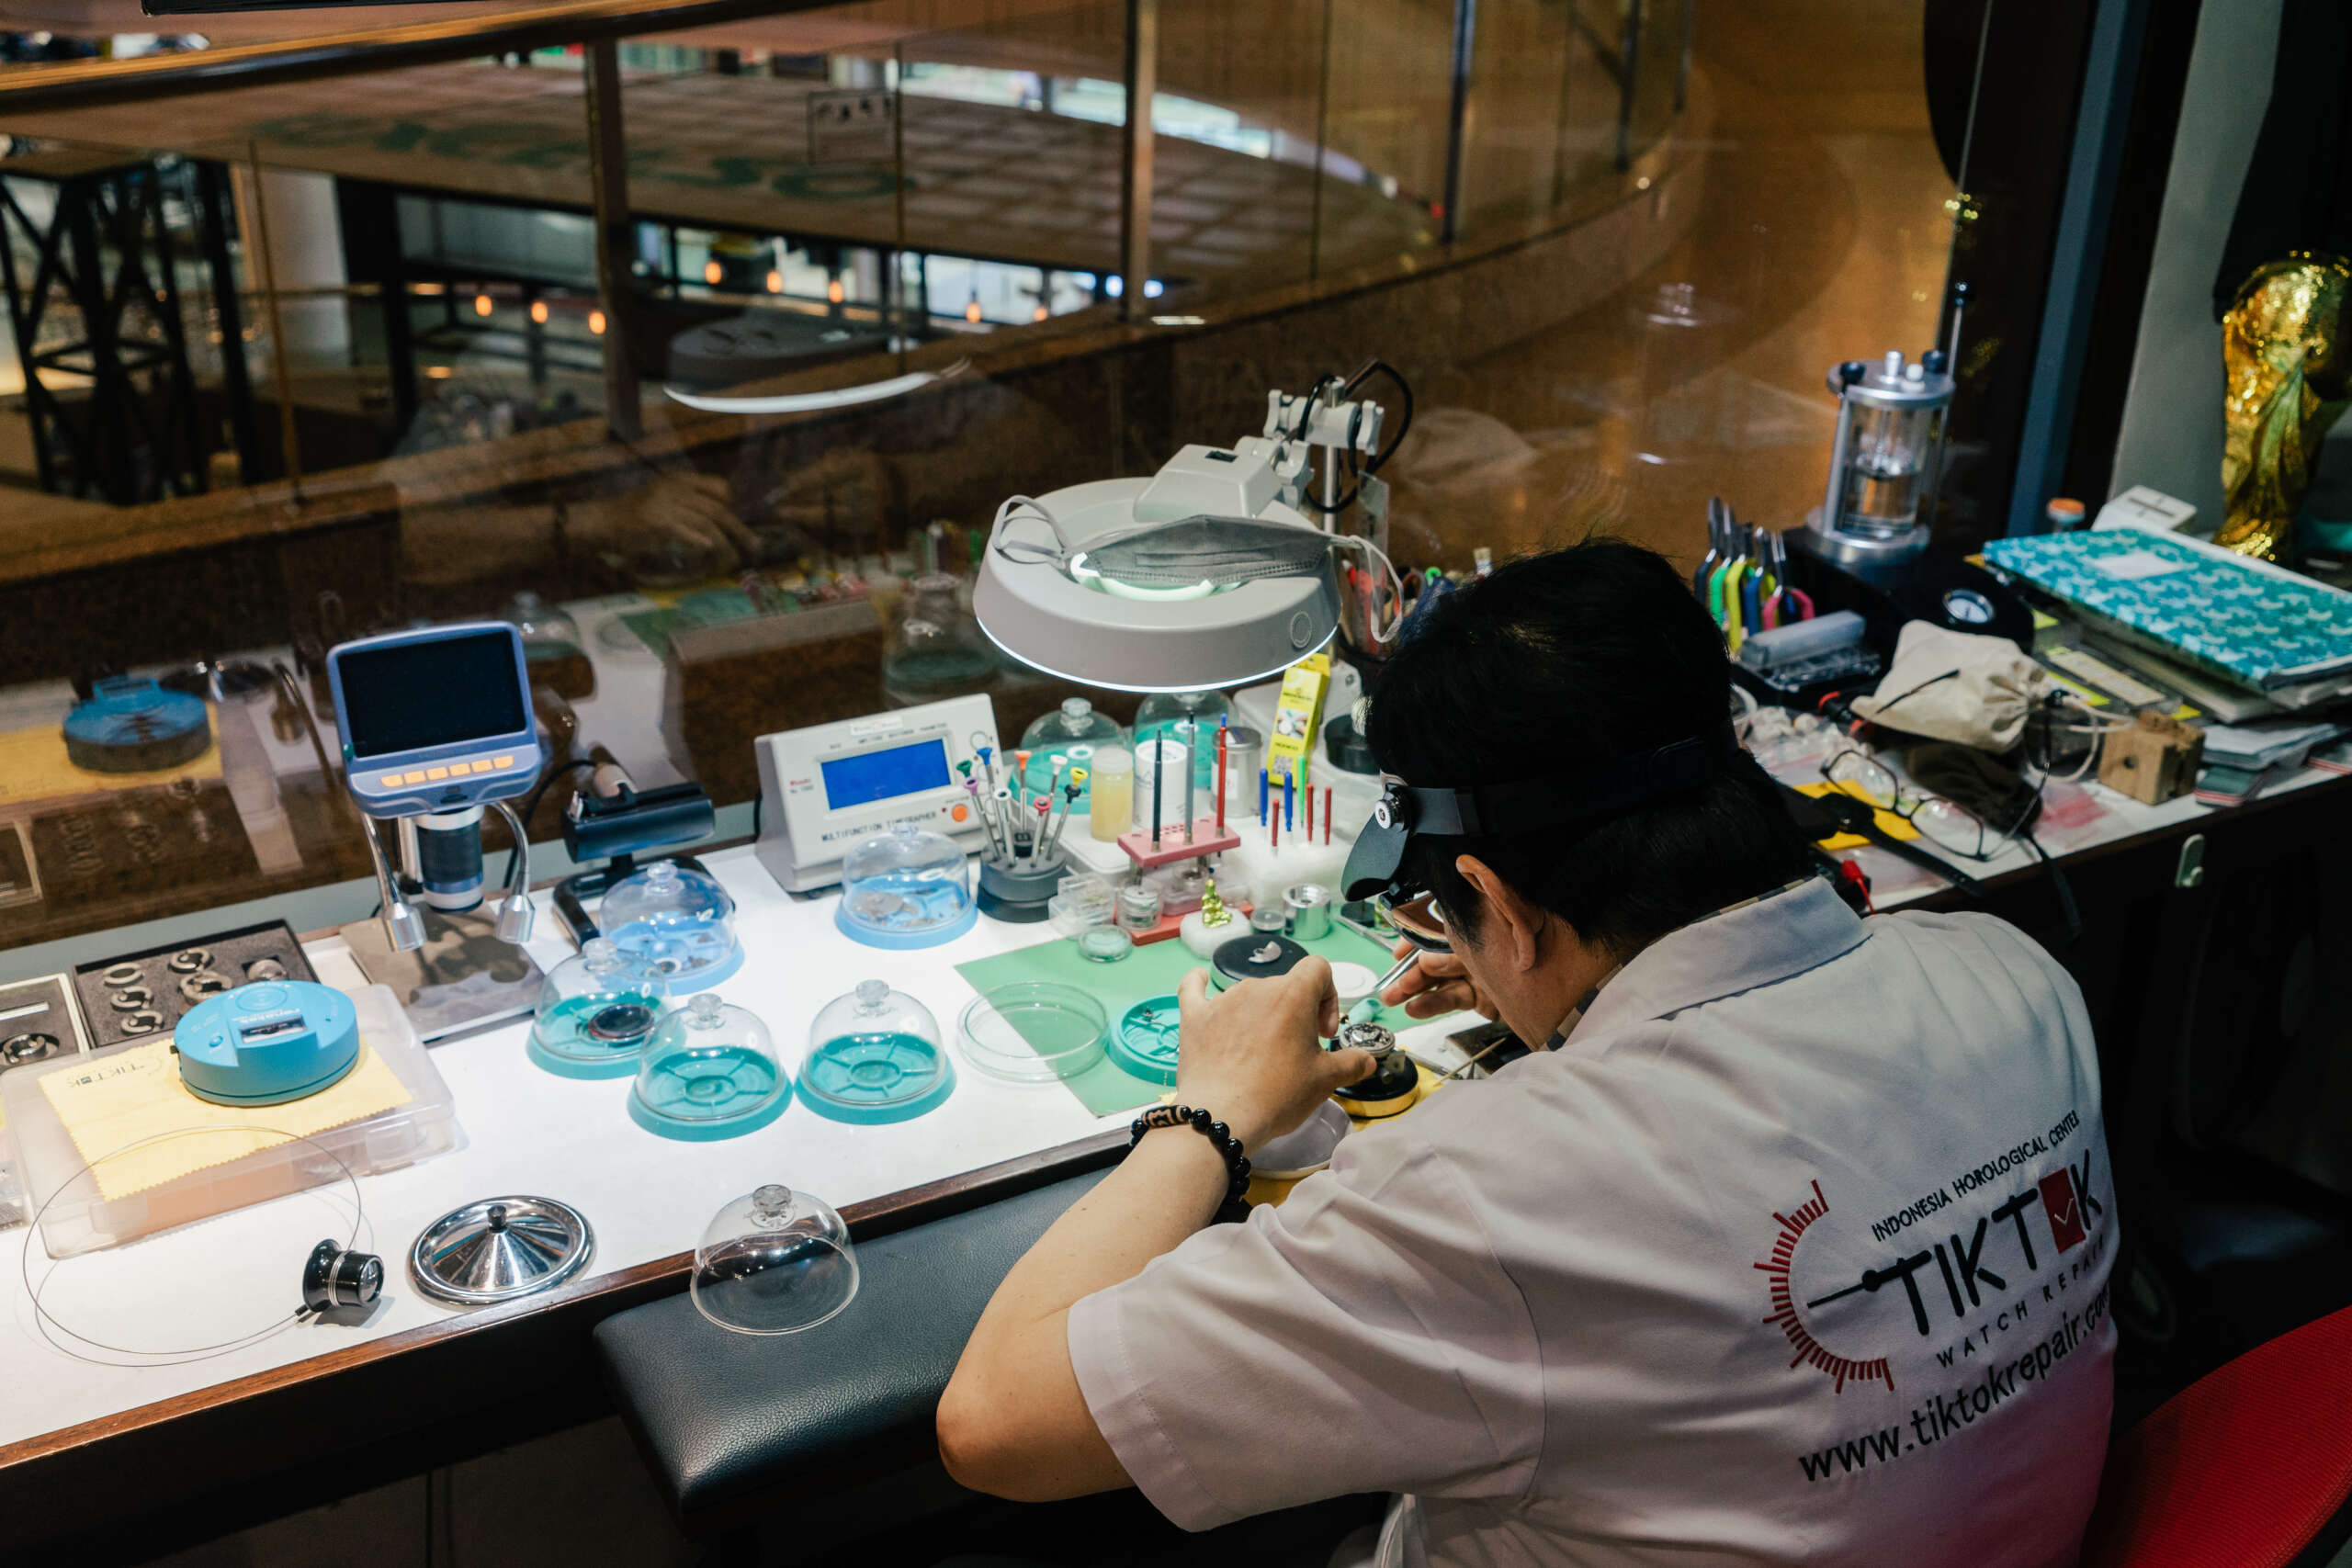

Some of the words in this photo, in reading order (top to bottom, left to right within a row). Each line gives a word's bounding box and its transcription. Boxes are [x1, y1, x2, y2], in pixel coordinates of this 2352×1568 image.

[1871, 1188, 1953, 1242] INDONESIA
[1951, 1136, 2049, 1199] HOROLOGICAL
[1936, 1300, 2029, 1369] WATCH
